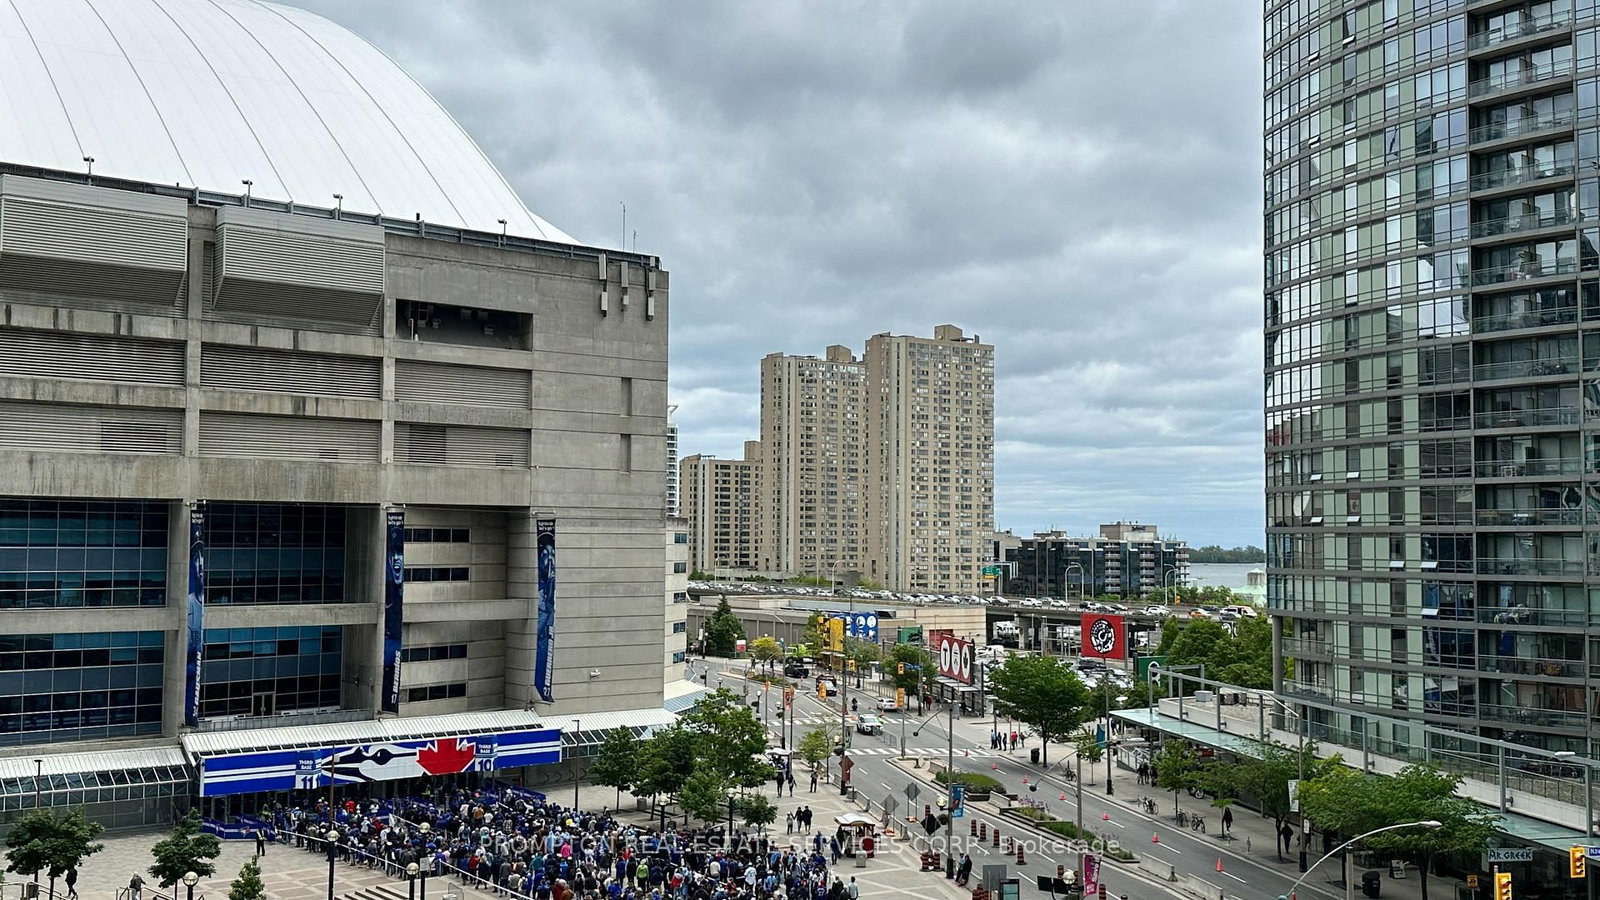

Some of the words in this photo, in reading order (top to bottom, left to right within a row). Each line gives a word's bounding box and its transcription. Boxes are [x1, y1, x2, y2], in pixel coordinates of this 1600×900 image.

[544, 638, 554, 687] GUERRERO
[478, 759, 492, 772] 10
[301, 775, 314, 789] 11
[1505, 850, 1532, 860] GREEK
